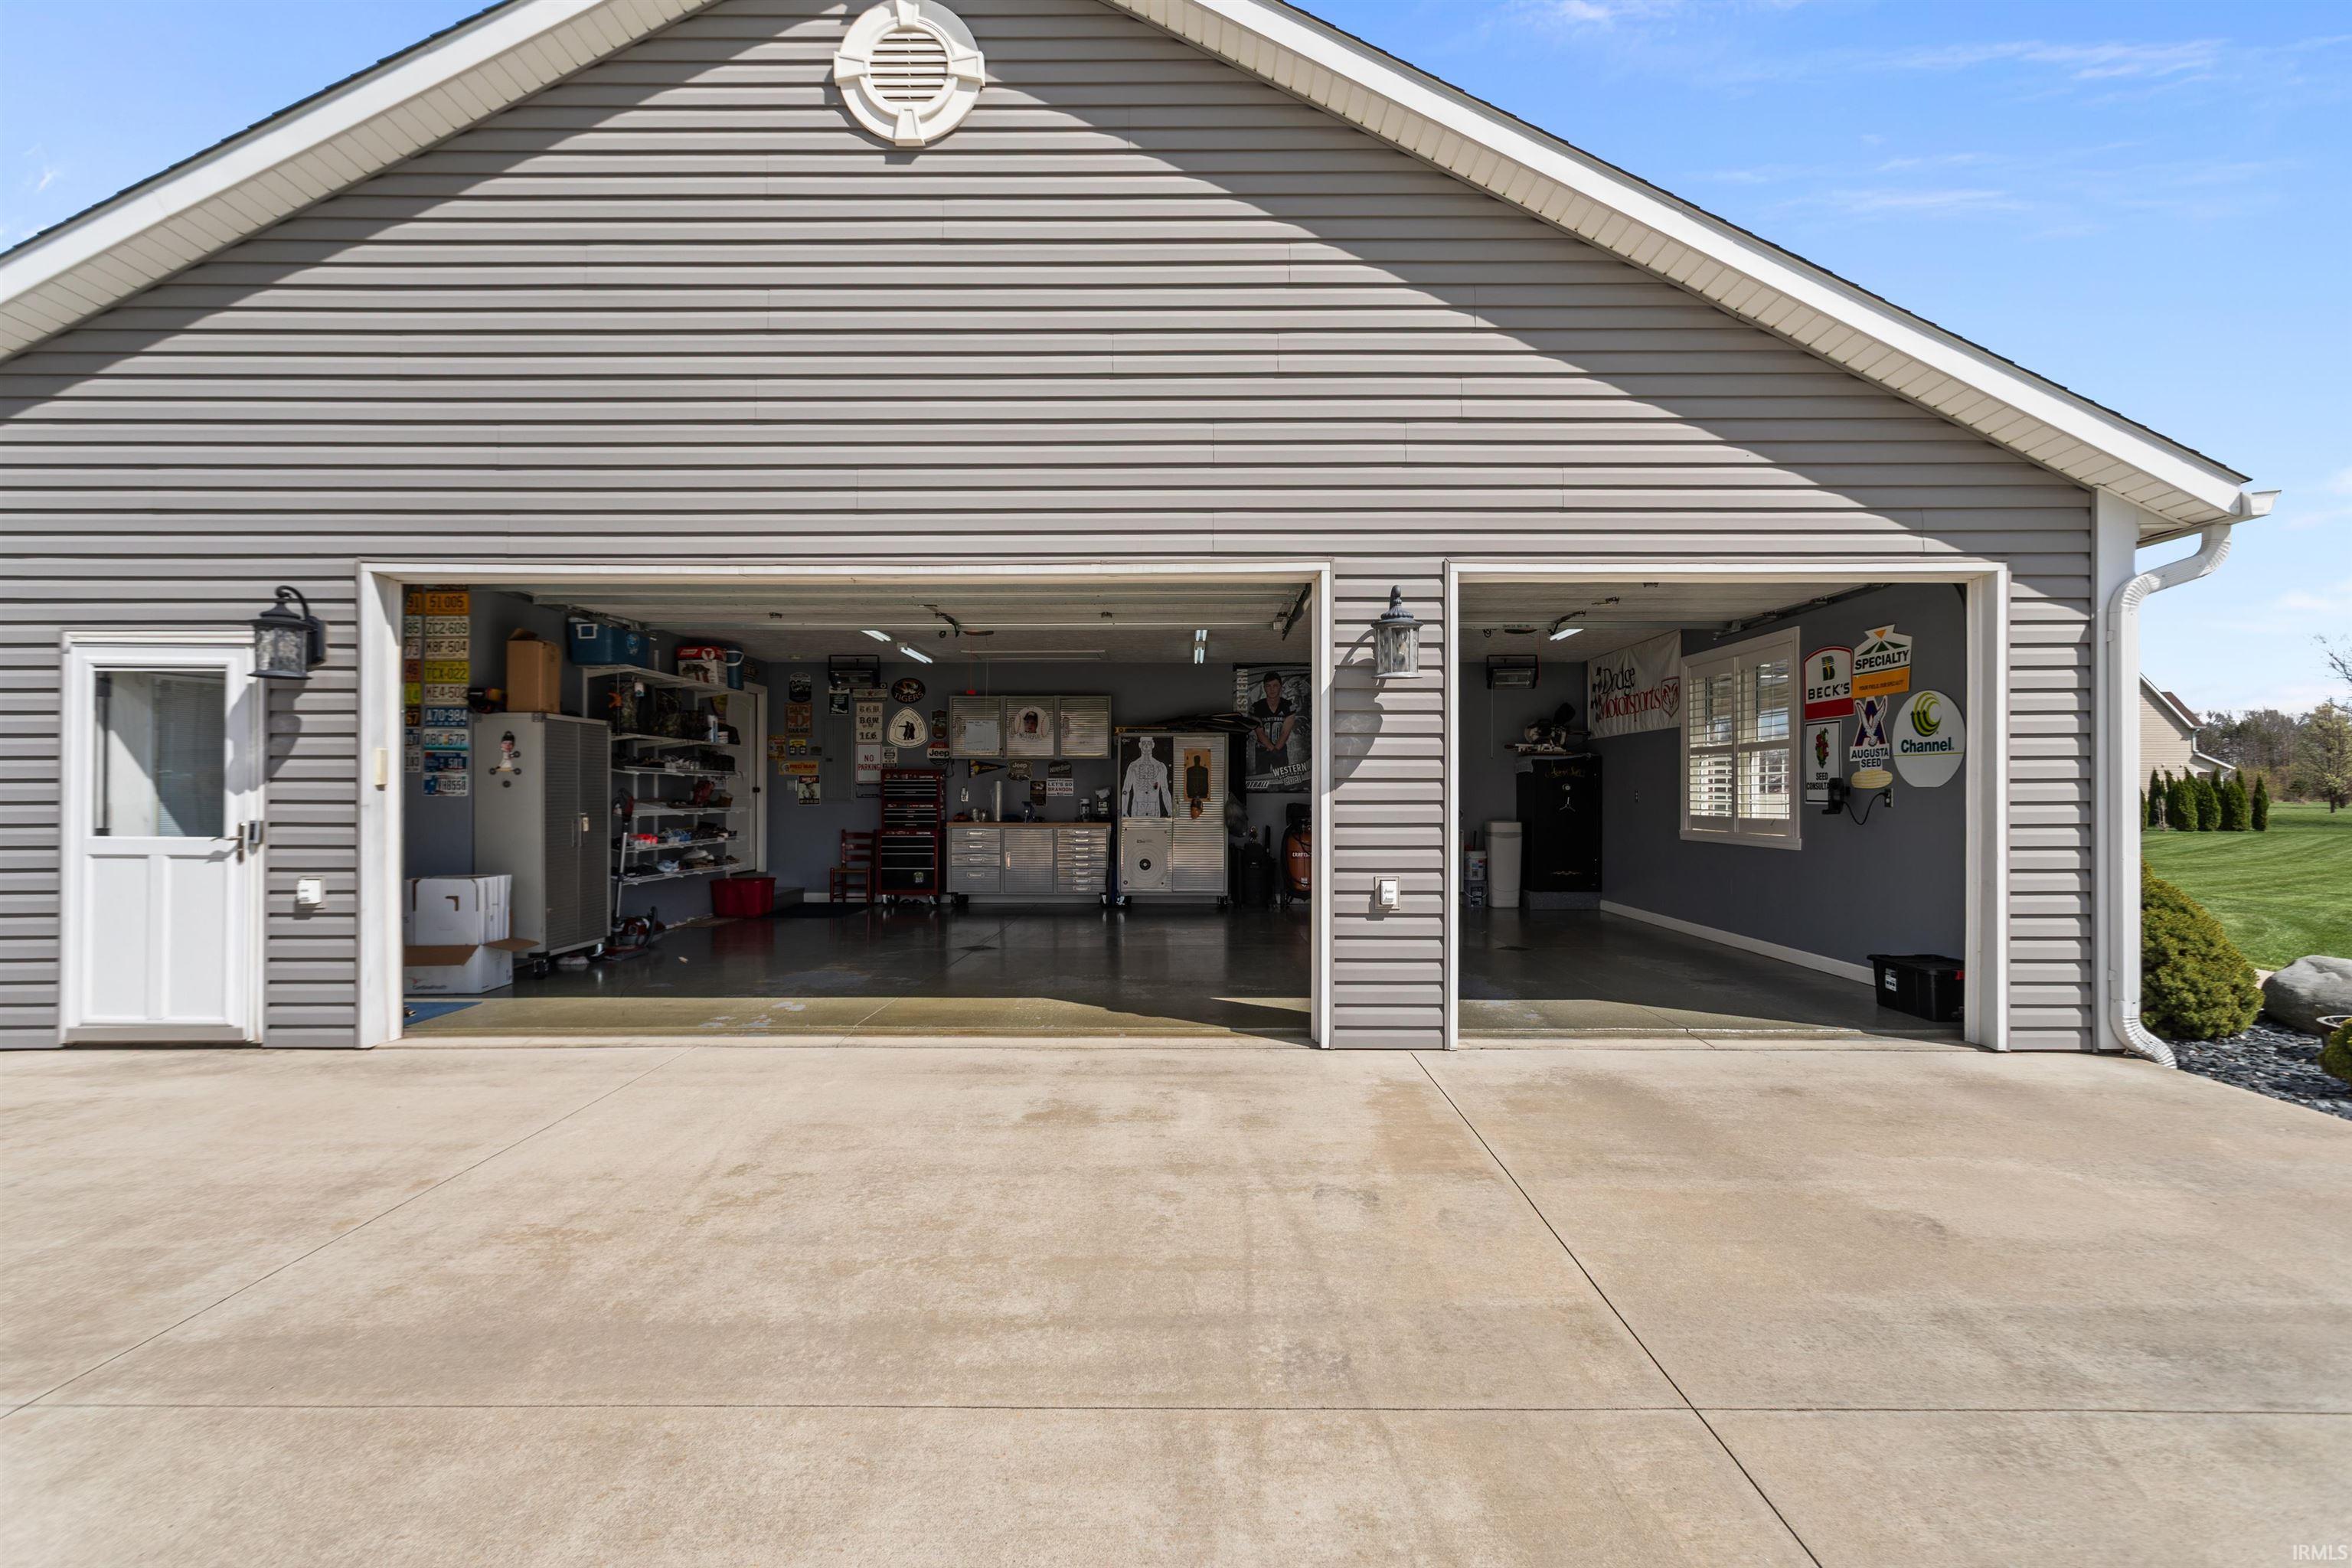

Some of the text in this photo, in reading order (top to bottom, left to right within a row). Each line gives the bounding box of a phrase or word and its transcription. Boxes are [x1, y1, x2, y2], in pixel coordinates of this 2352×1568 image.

[1854, 649, 1909, 670] SPECIALTY
[1601, 664, 1635, 695] Dodge
[893, 691, 924, 702] TIGERS
[1808, 682, 1850, 700] BECK'S
[1598, 686, 1661, 722] Motorsports
[1901, 737, 1952, 753] Channel
[1851, 747, 1889, 759] AUGUSTA
[1272, 762, 1308, 777] WESTERN
[1860, 760, 1881, 768] SEED
[1815, 772, 1828, 780] SEED
